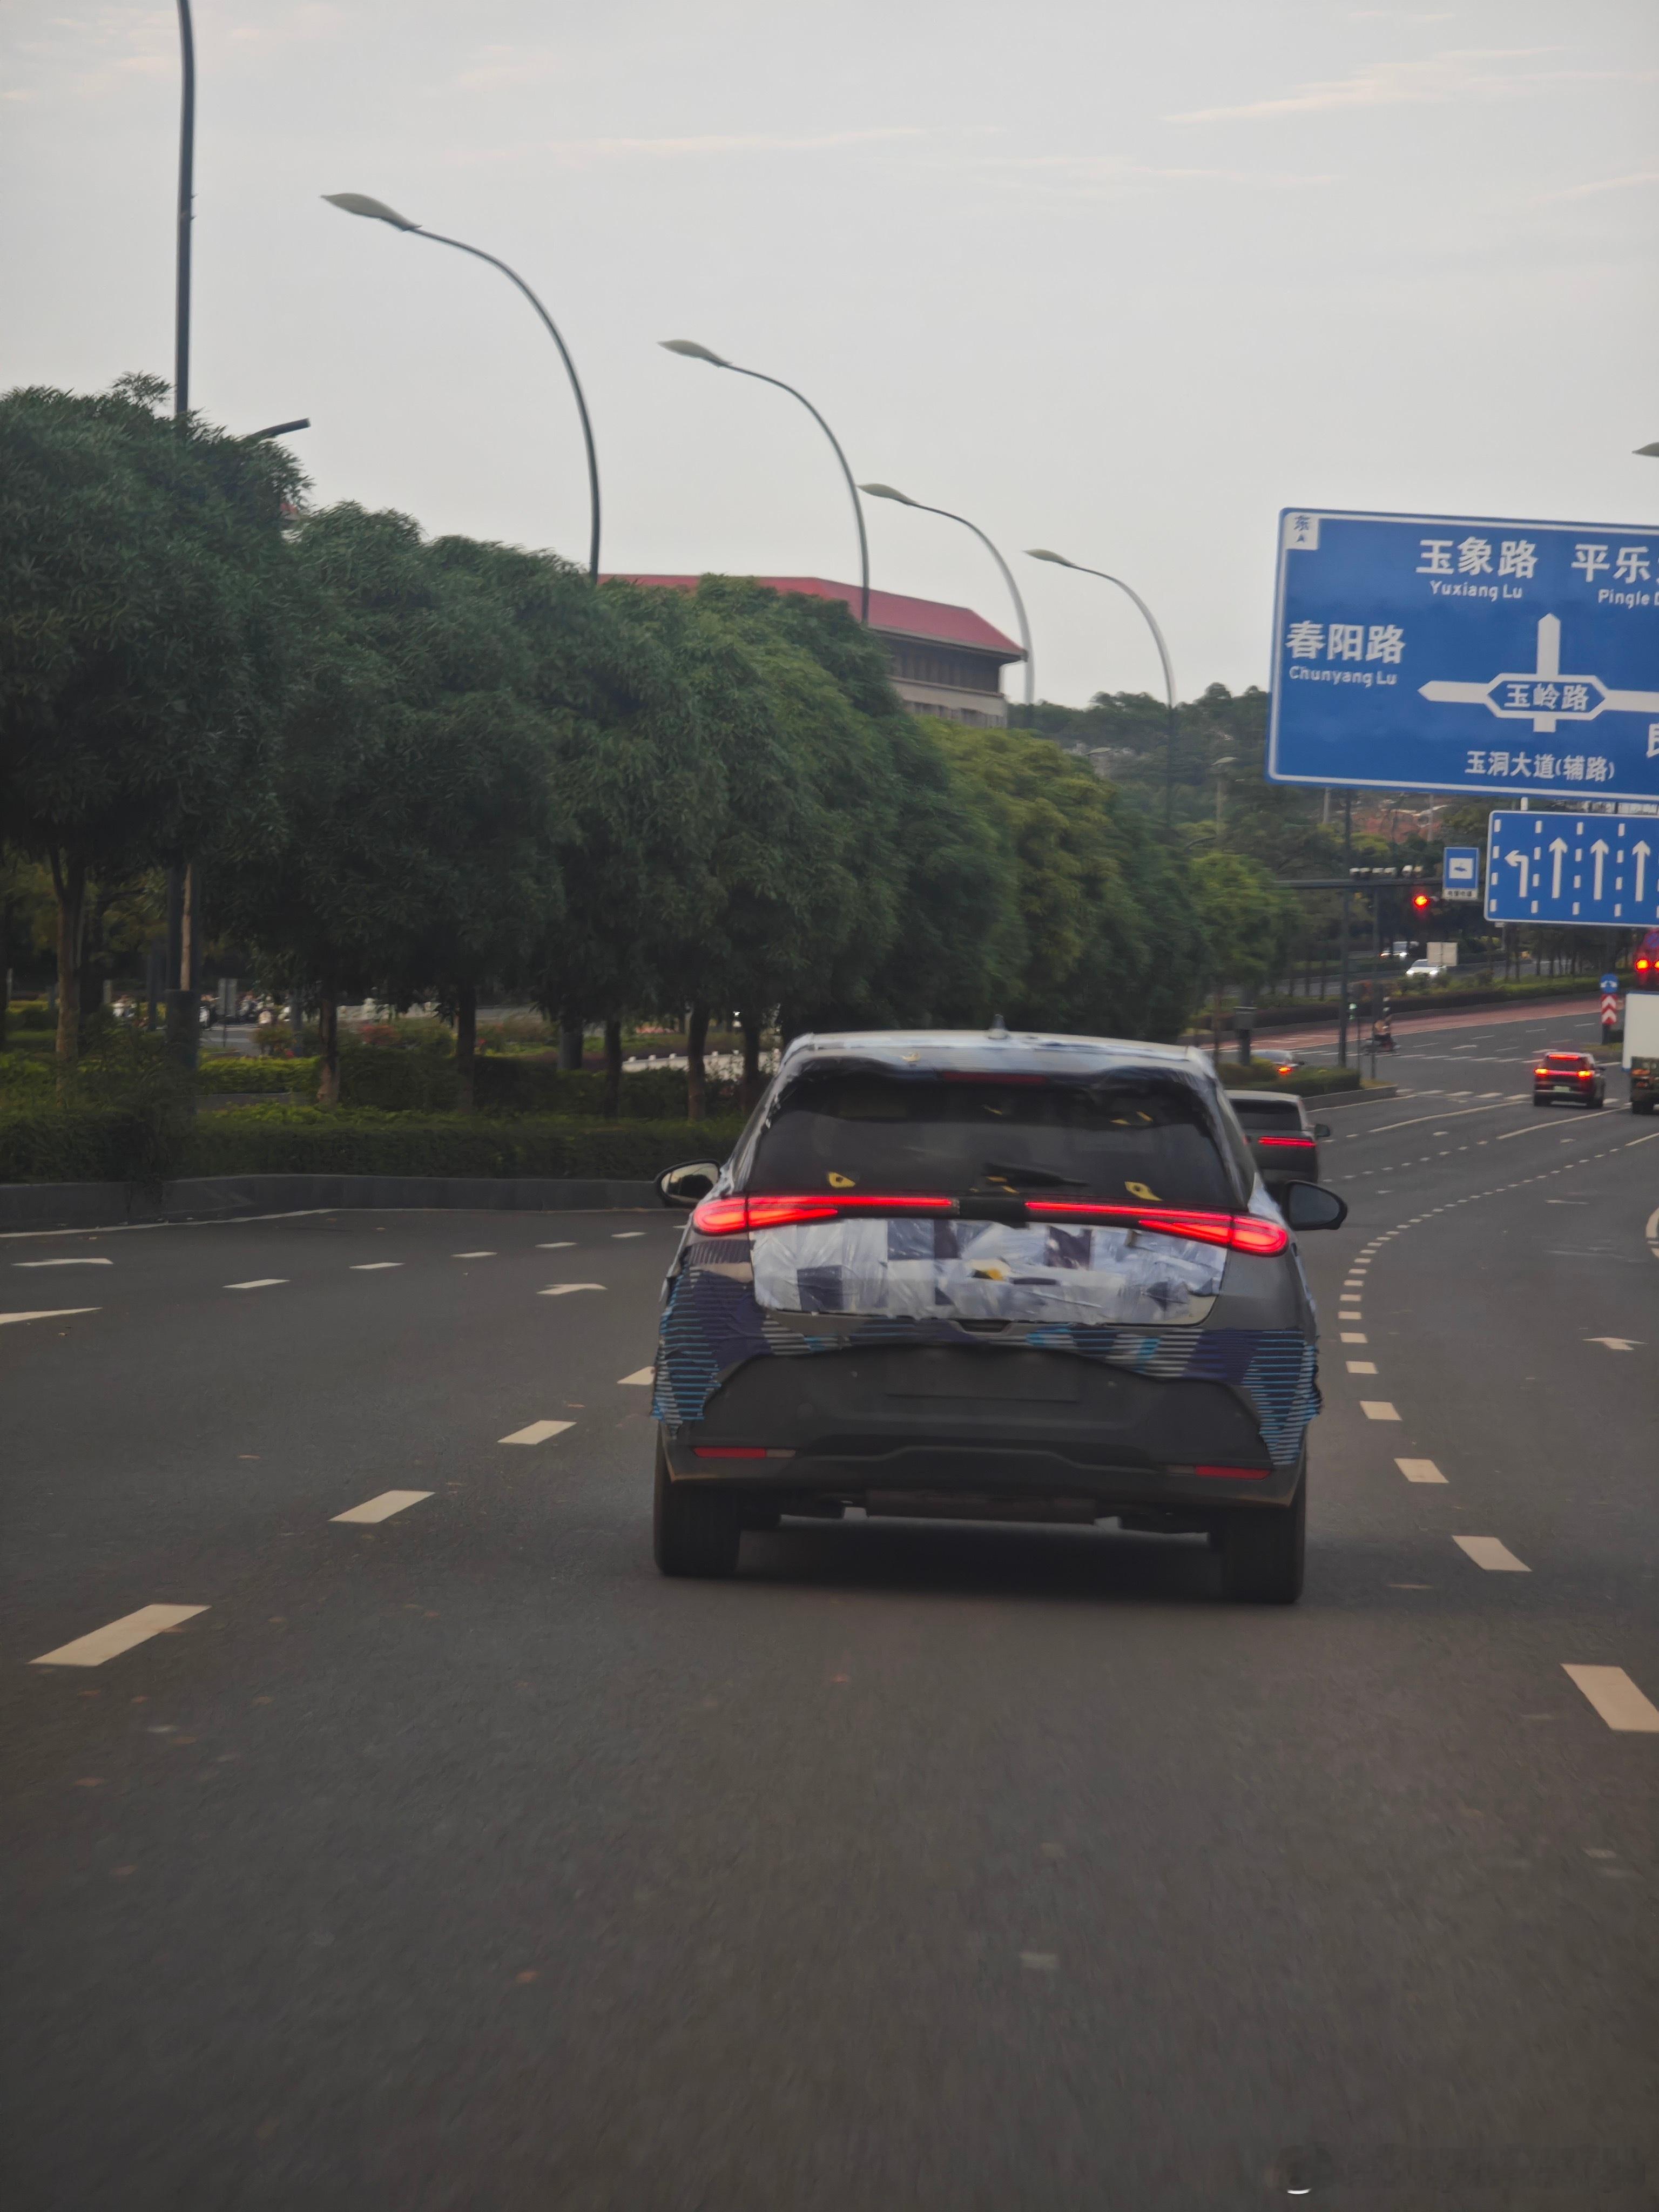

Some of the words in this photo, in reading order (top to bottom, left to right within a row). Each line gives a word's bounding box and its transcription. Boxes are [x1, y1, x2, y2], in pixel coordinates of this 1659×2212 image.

[1415, 536, 1538, 579] 玉象路
[1571, 543, 1659, 585] 平乐
[1429, 580, 1498, 602] Yuxiang
[1503, 584, 1523, 599] Lu
[1598, 589, 1650, 609] Pingle
[1285, 621, 1406, 664] 春阳路
[1289, 665, 1372, 687] Chunyang
[1377, 671, 1397, 685] Lu
[1503, 683, 1590, 711] 玉岭路
